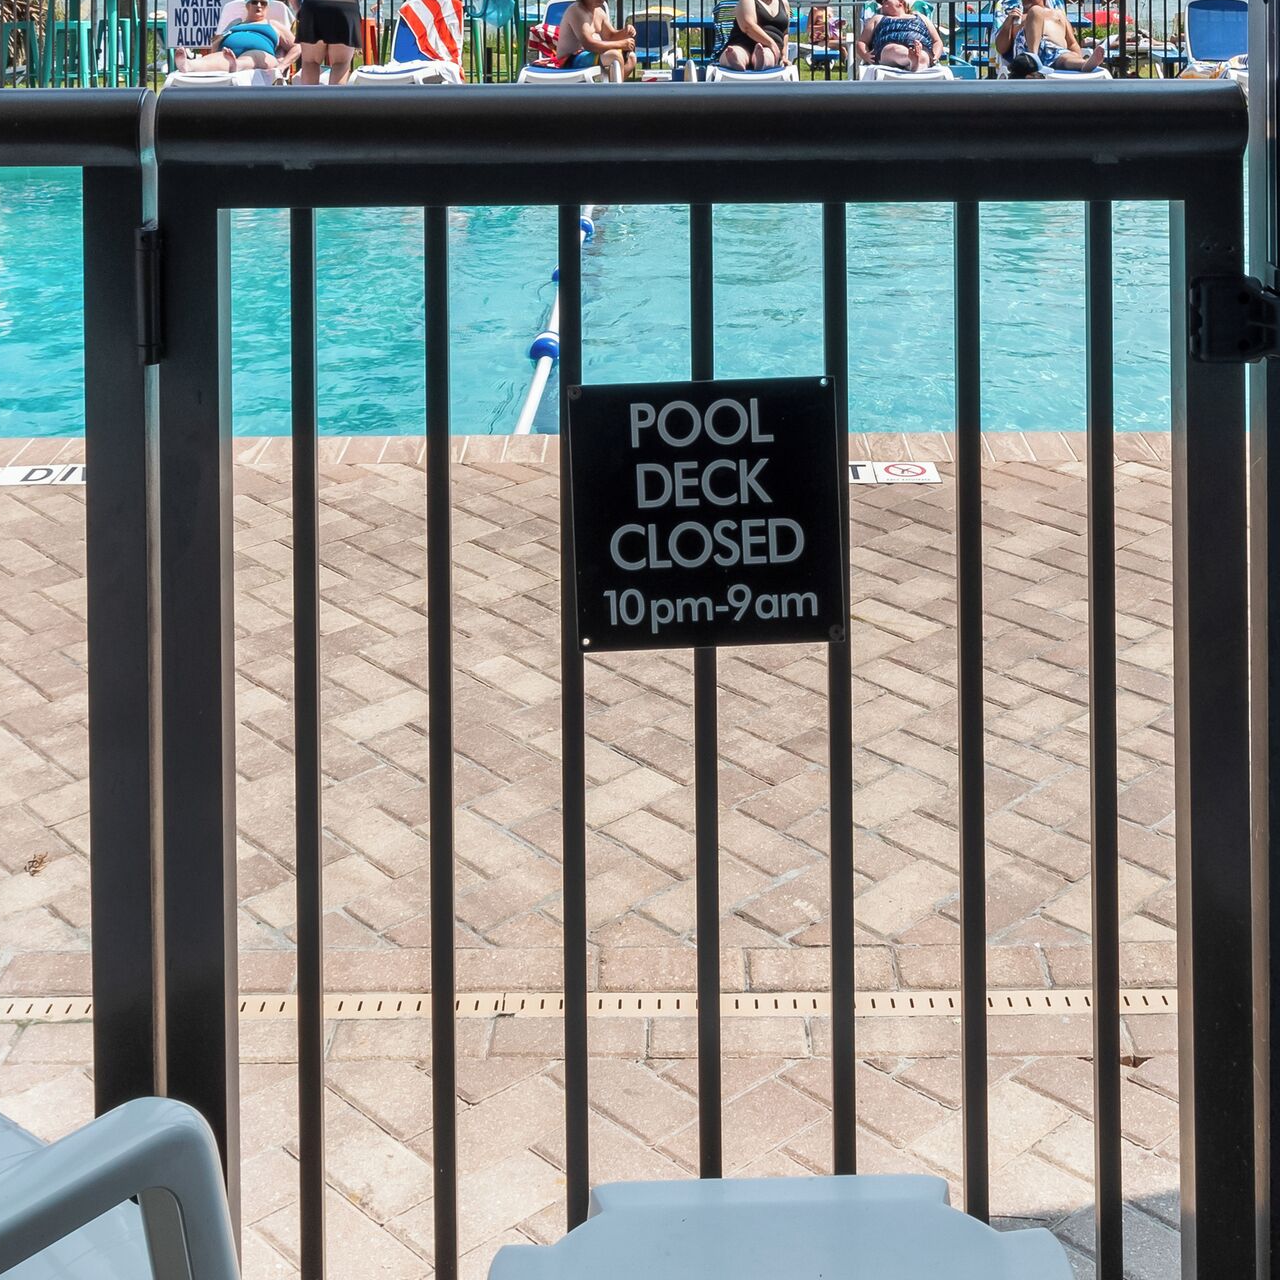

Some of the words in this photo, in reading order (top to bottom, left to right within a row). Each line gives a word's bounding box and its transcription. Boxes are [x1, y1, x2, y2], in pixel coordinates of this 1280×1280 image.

[174, 8, 190, 27] NO
[192, 8, 220, 27] DIVIN
[629, 398, 774, 448] POOL
[635, 458, 773, 509] DECK
[609, 518, 805, 571] CLOSED
